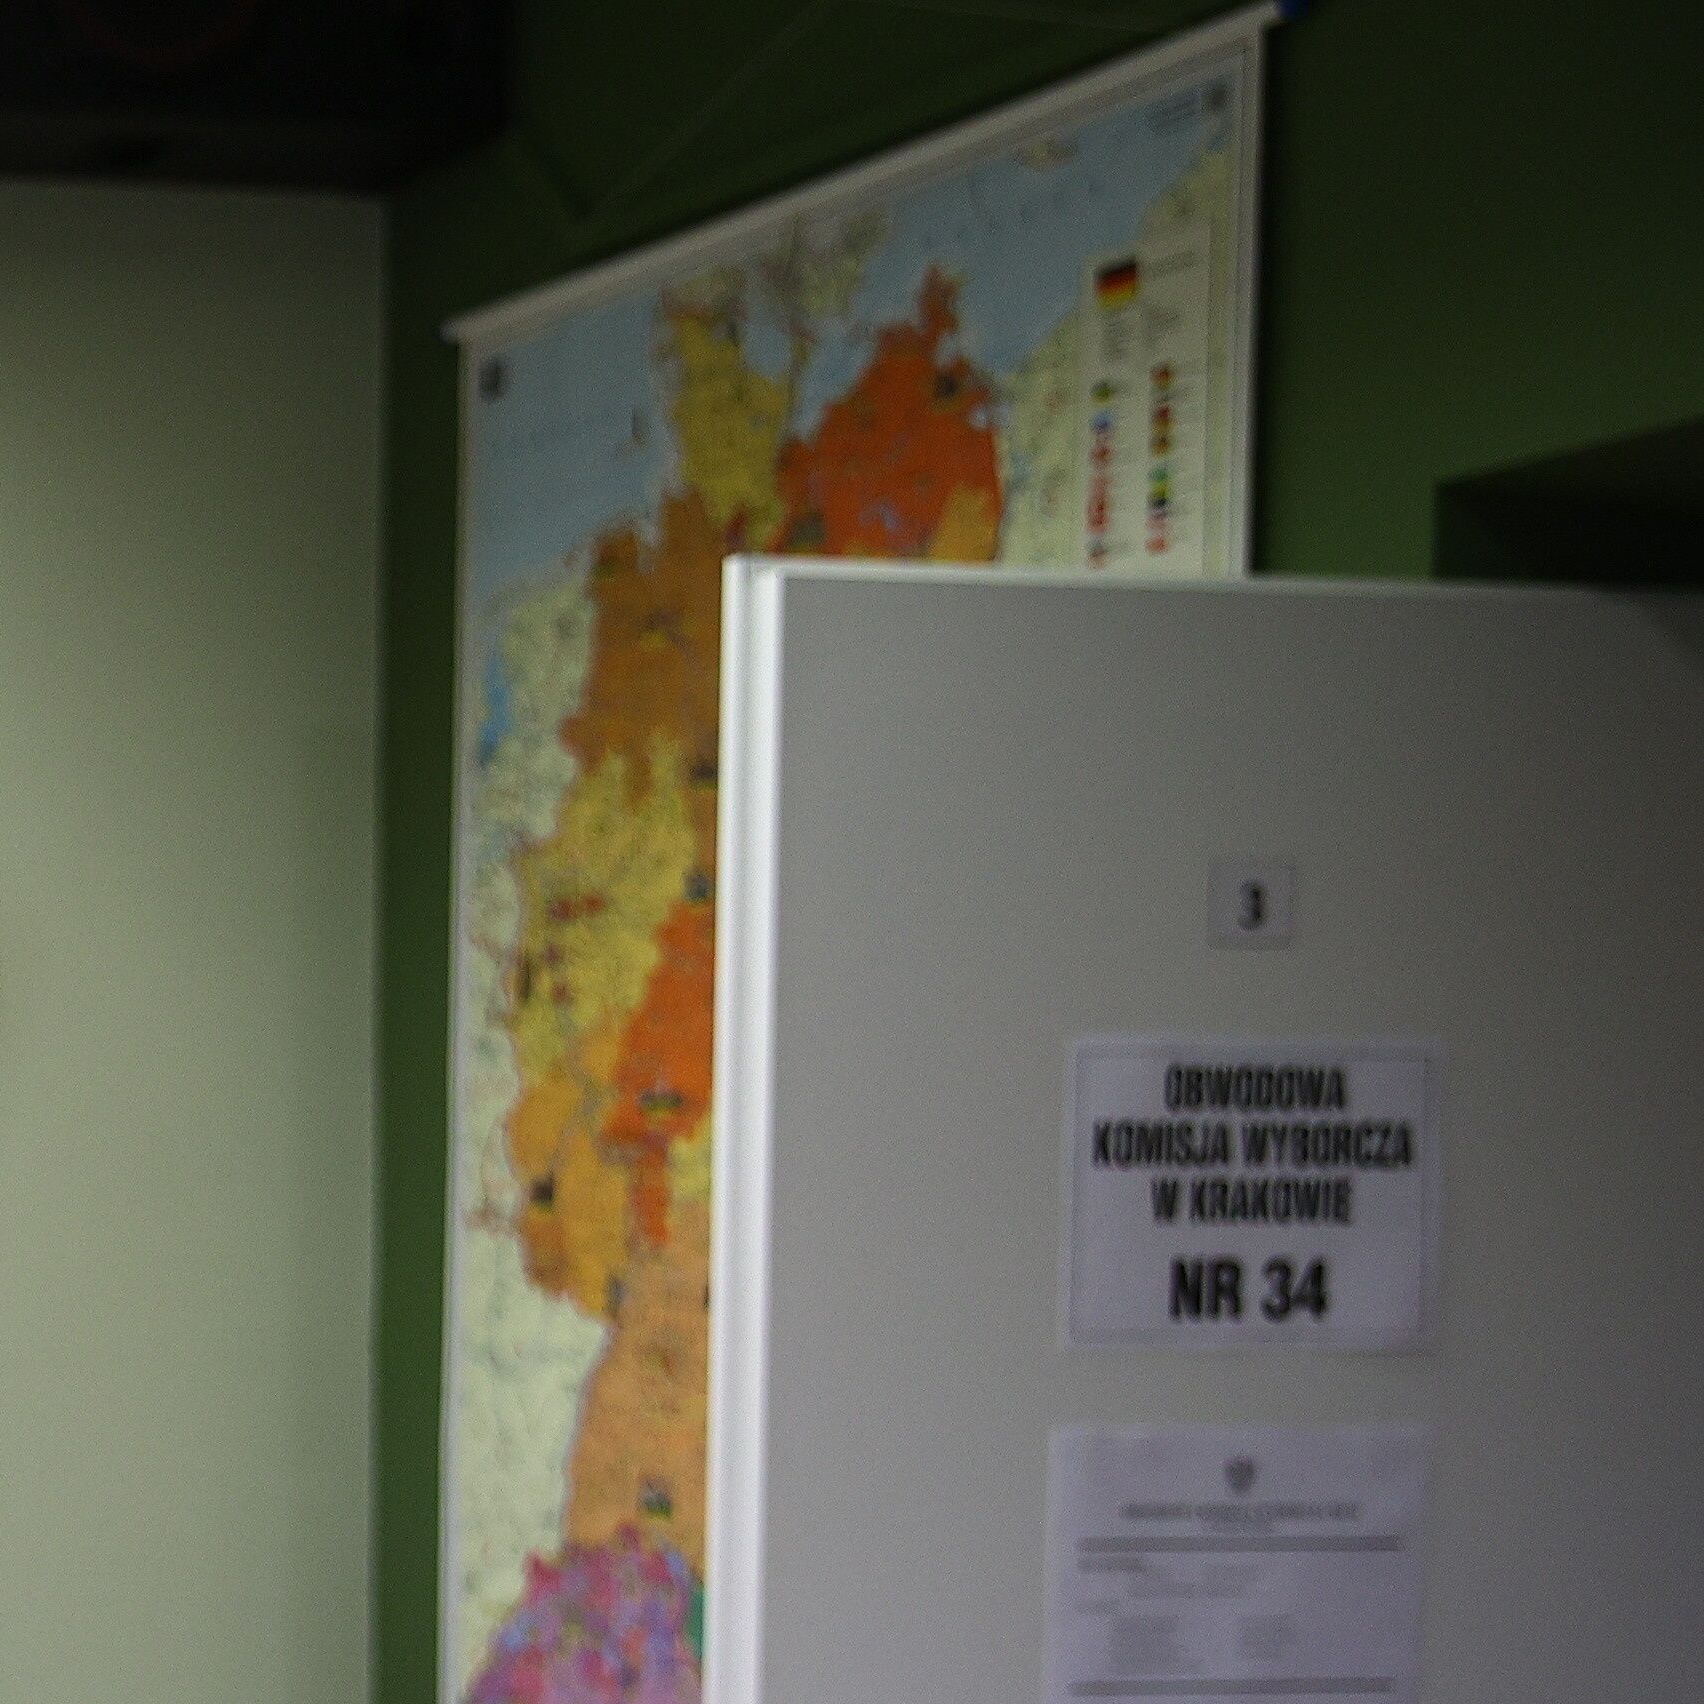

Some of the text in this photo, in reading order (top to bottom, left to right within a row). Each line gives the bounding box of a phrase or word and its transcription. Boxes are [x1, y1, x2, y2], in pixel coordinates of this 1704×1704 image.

[1237, 880, 1266, 931] 3
[1164, 1064, 1346, 1111] OBWODOWA
[1093, 1119, 1413, 1169] KOMISJA WYBORCZA
[1151, 1176, 1353, 1225] W KRAKOWIE
[1168, 1256, 1329, 1323] NR 34
